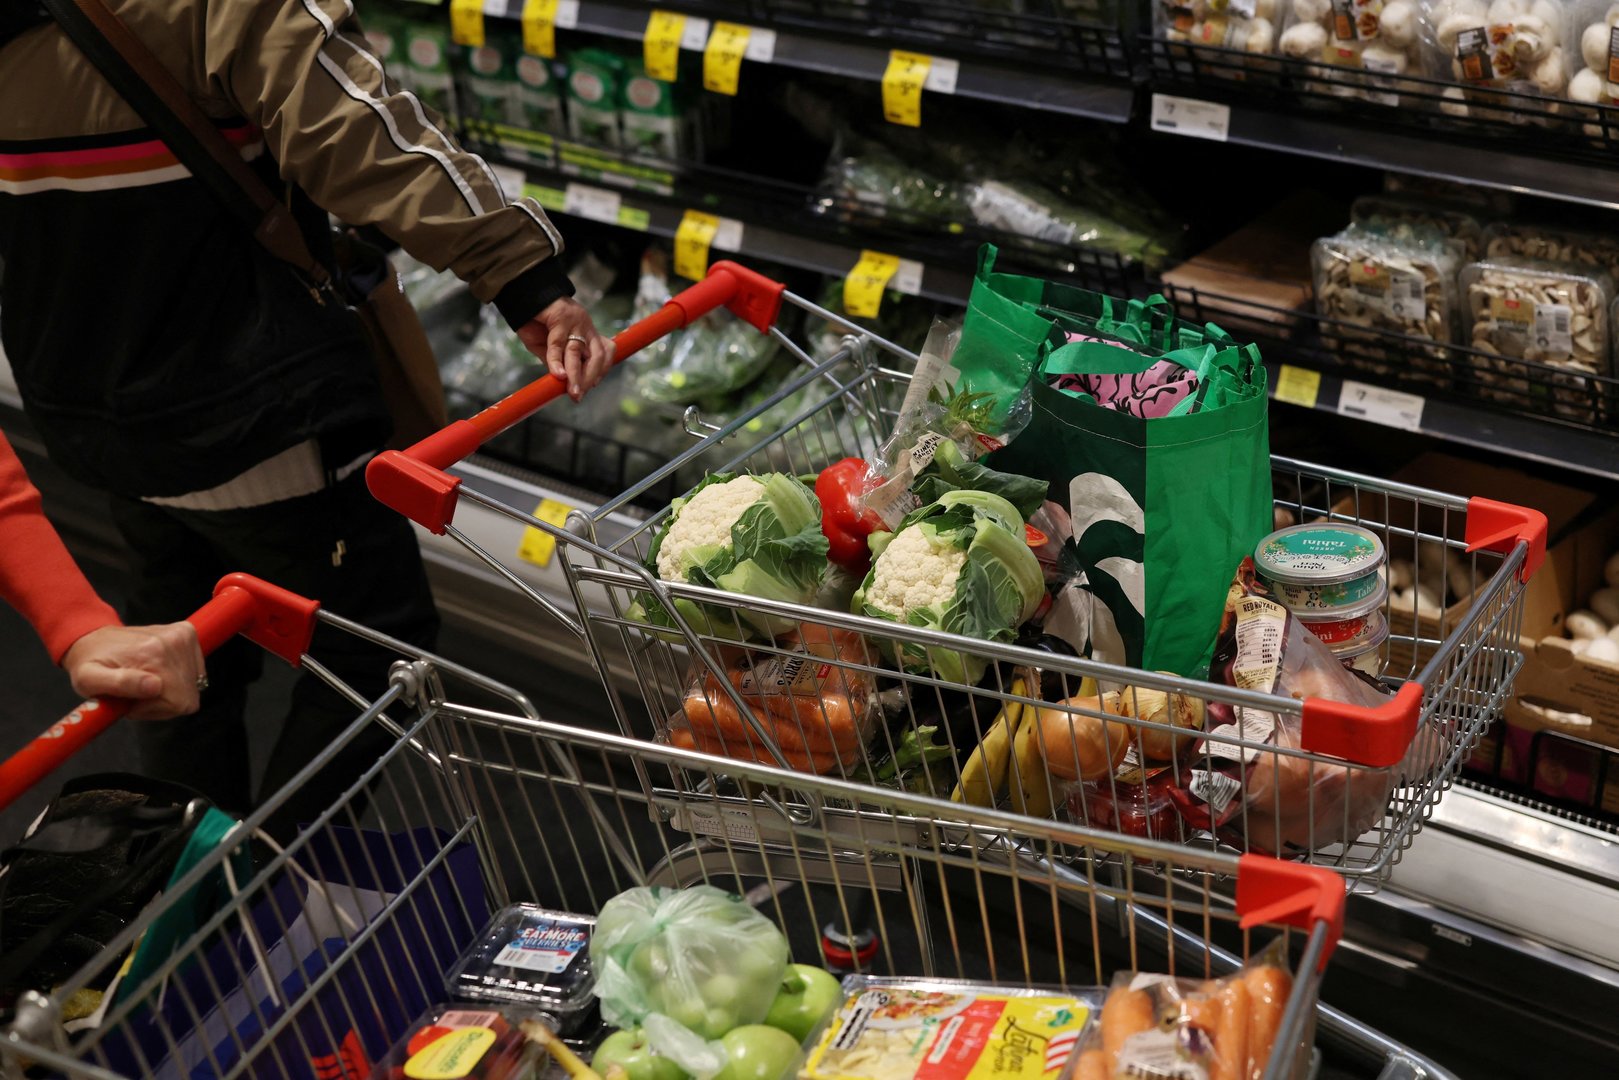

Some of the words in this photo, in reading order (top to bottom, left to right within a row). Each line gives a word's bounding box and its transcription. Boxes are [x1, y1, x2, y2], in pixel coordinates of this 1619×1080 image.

[912, 435, 941, 457] NTINENTAL
[1302, 539, 1347, 547] Tahini
[1243, 602, 1255, 612] RED
[1254, 601, 1277, 612] ROYALE
[521, 927, 584, 942] EATMORE
[1003, 1015, 1049, 1073] Latina
